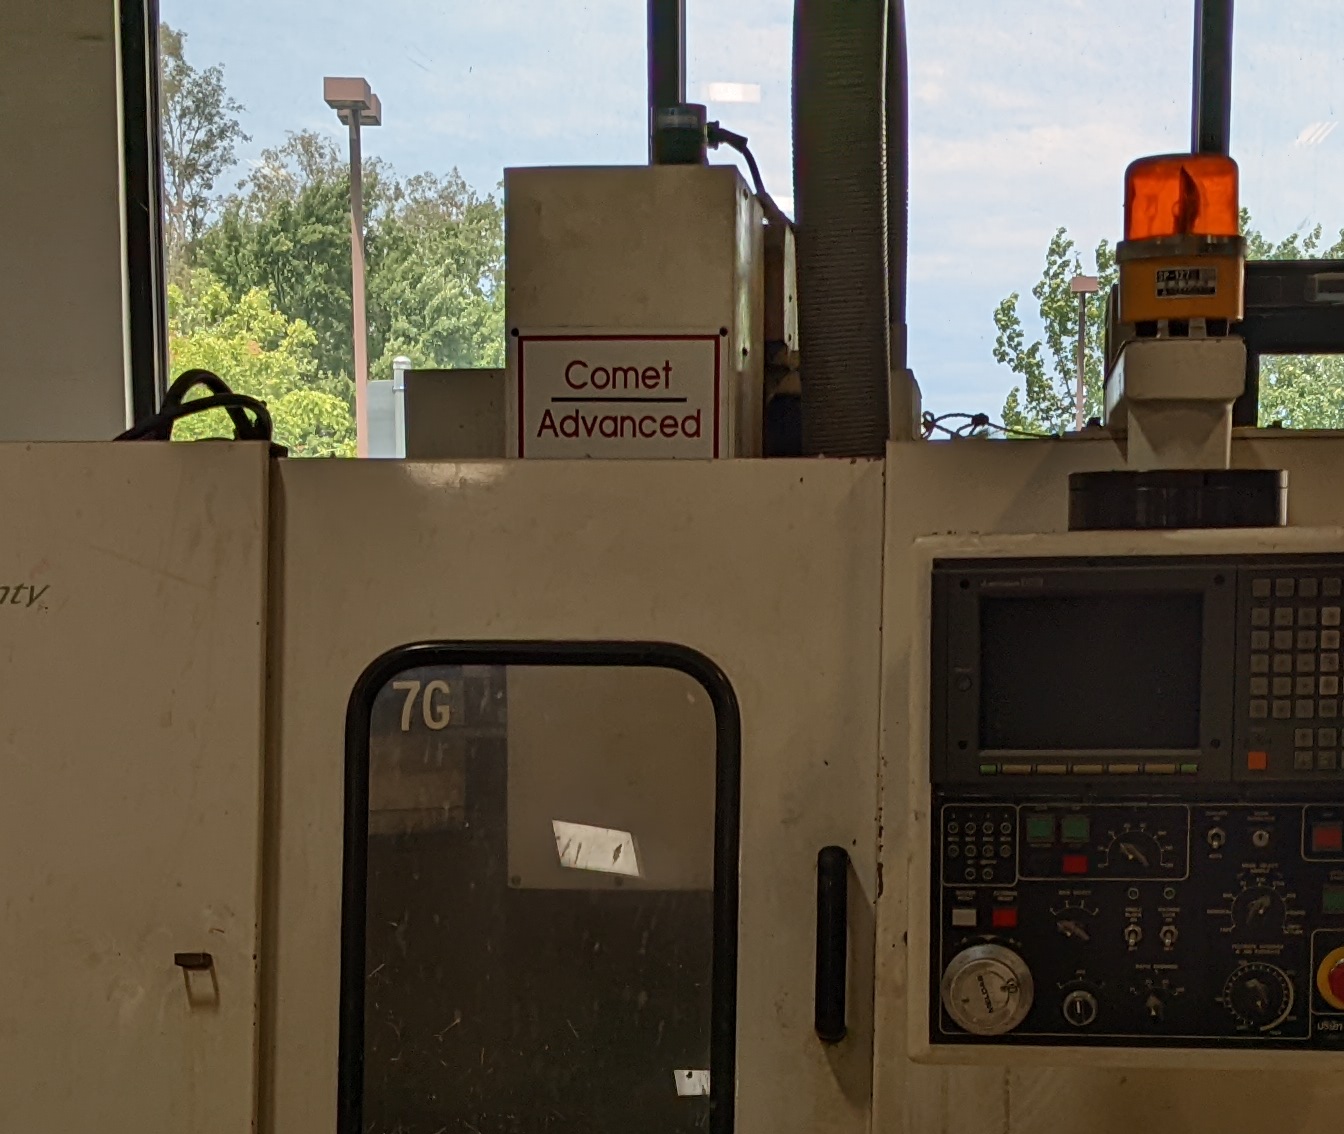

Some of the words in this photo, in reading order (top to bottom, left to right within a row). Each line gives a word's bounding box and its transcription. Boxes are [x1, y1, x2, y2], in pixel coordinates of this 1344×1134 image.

[565, 360, 672, 390] Comet
[537, 408, 701, 438] Advanced
[393, 680, 450, 731] 7G
